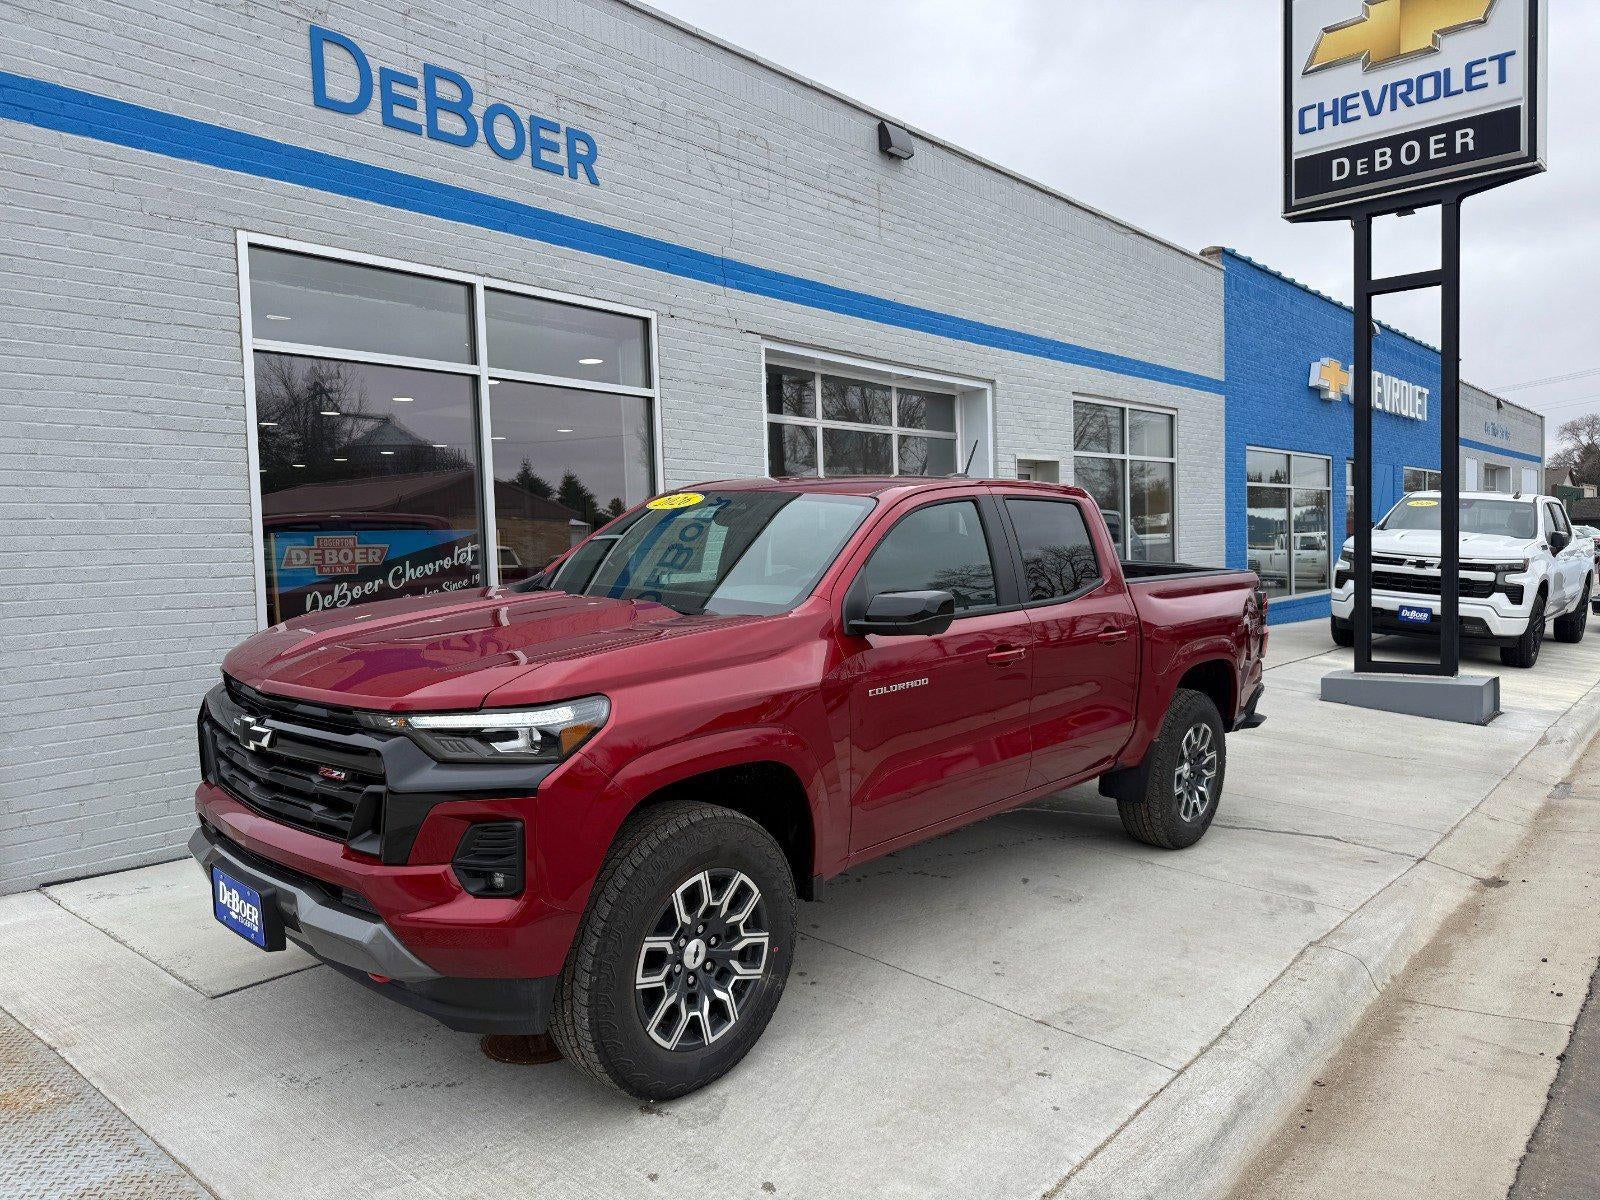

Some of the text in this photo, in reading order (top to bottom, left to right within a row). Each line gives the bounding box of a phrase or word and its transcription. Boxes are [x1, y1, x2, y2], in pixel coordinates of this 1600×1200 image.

[1298, 49, 1517, 135] CHEVROLET
[1349, 365, 1430, 421] EVROLET
[319, 537, 355, 548] EDGERTON
[292, 548, 383, 565] DEBOER
[305, 541, 475, 613] DeBoer Chevrolet
[442, 577, 469, 592] Since
[868, 677, 929, 697] COLORADO
